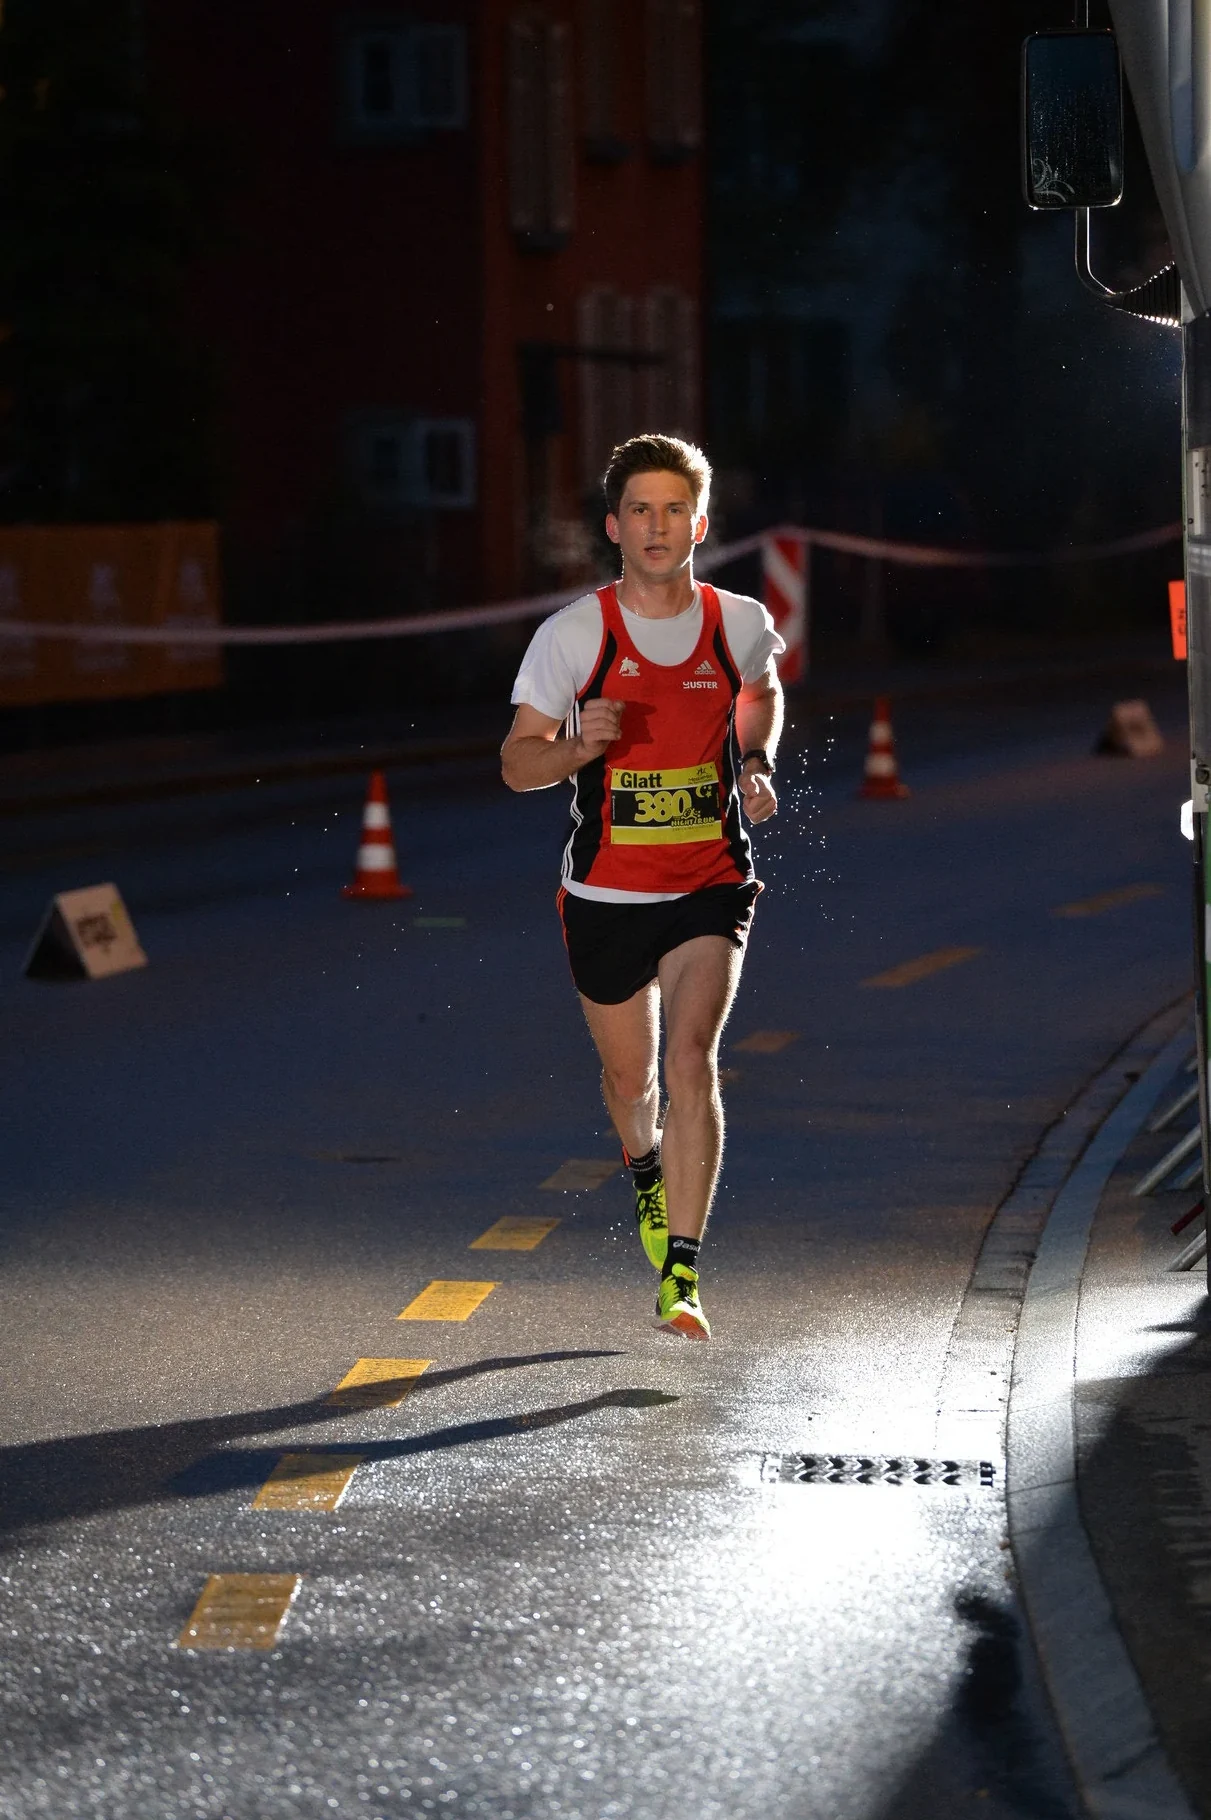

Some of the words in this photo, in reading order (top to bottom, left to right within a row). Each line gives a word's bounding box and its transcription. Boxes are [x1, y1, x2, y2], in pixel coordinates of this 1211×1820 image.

[620, 772, 662, 789] Glatt
[634, 789, 692, 823] 380
[697, 816, 715, 824] RUN
